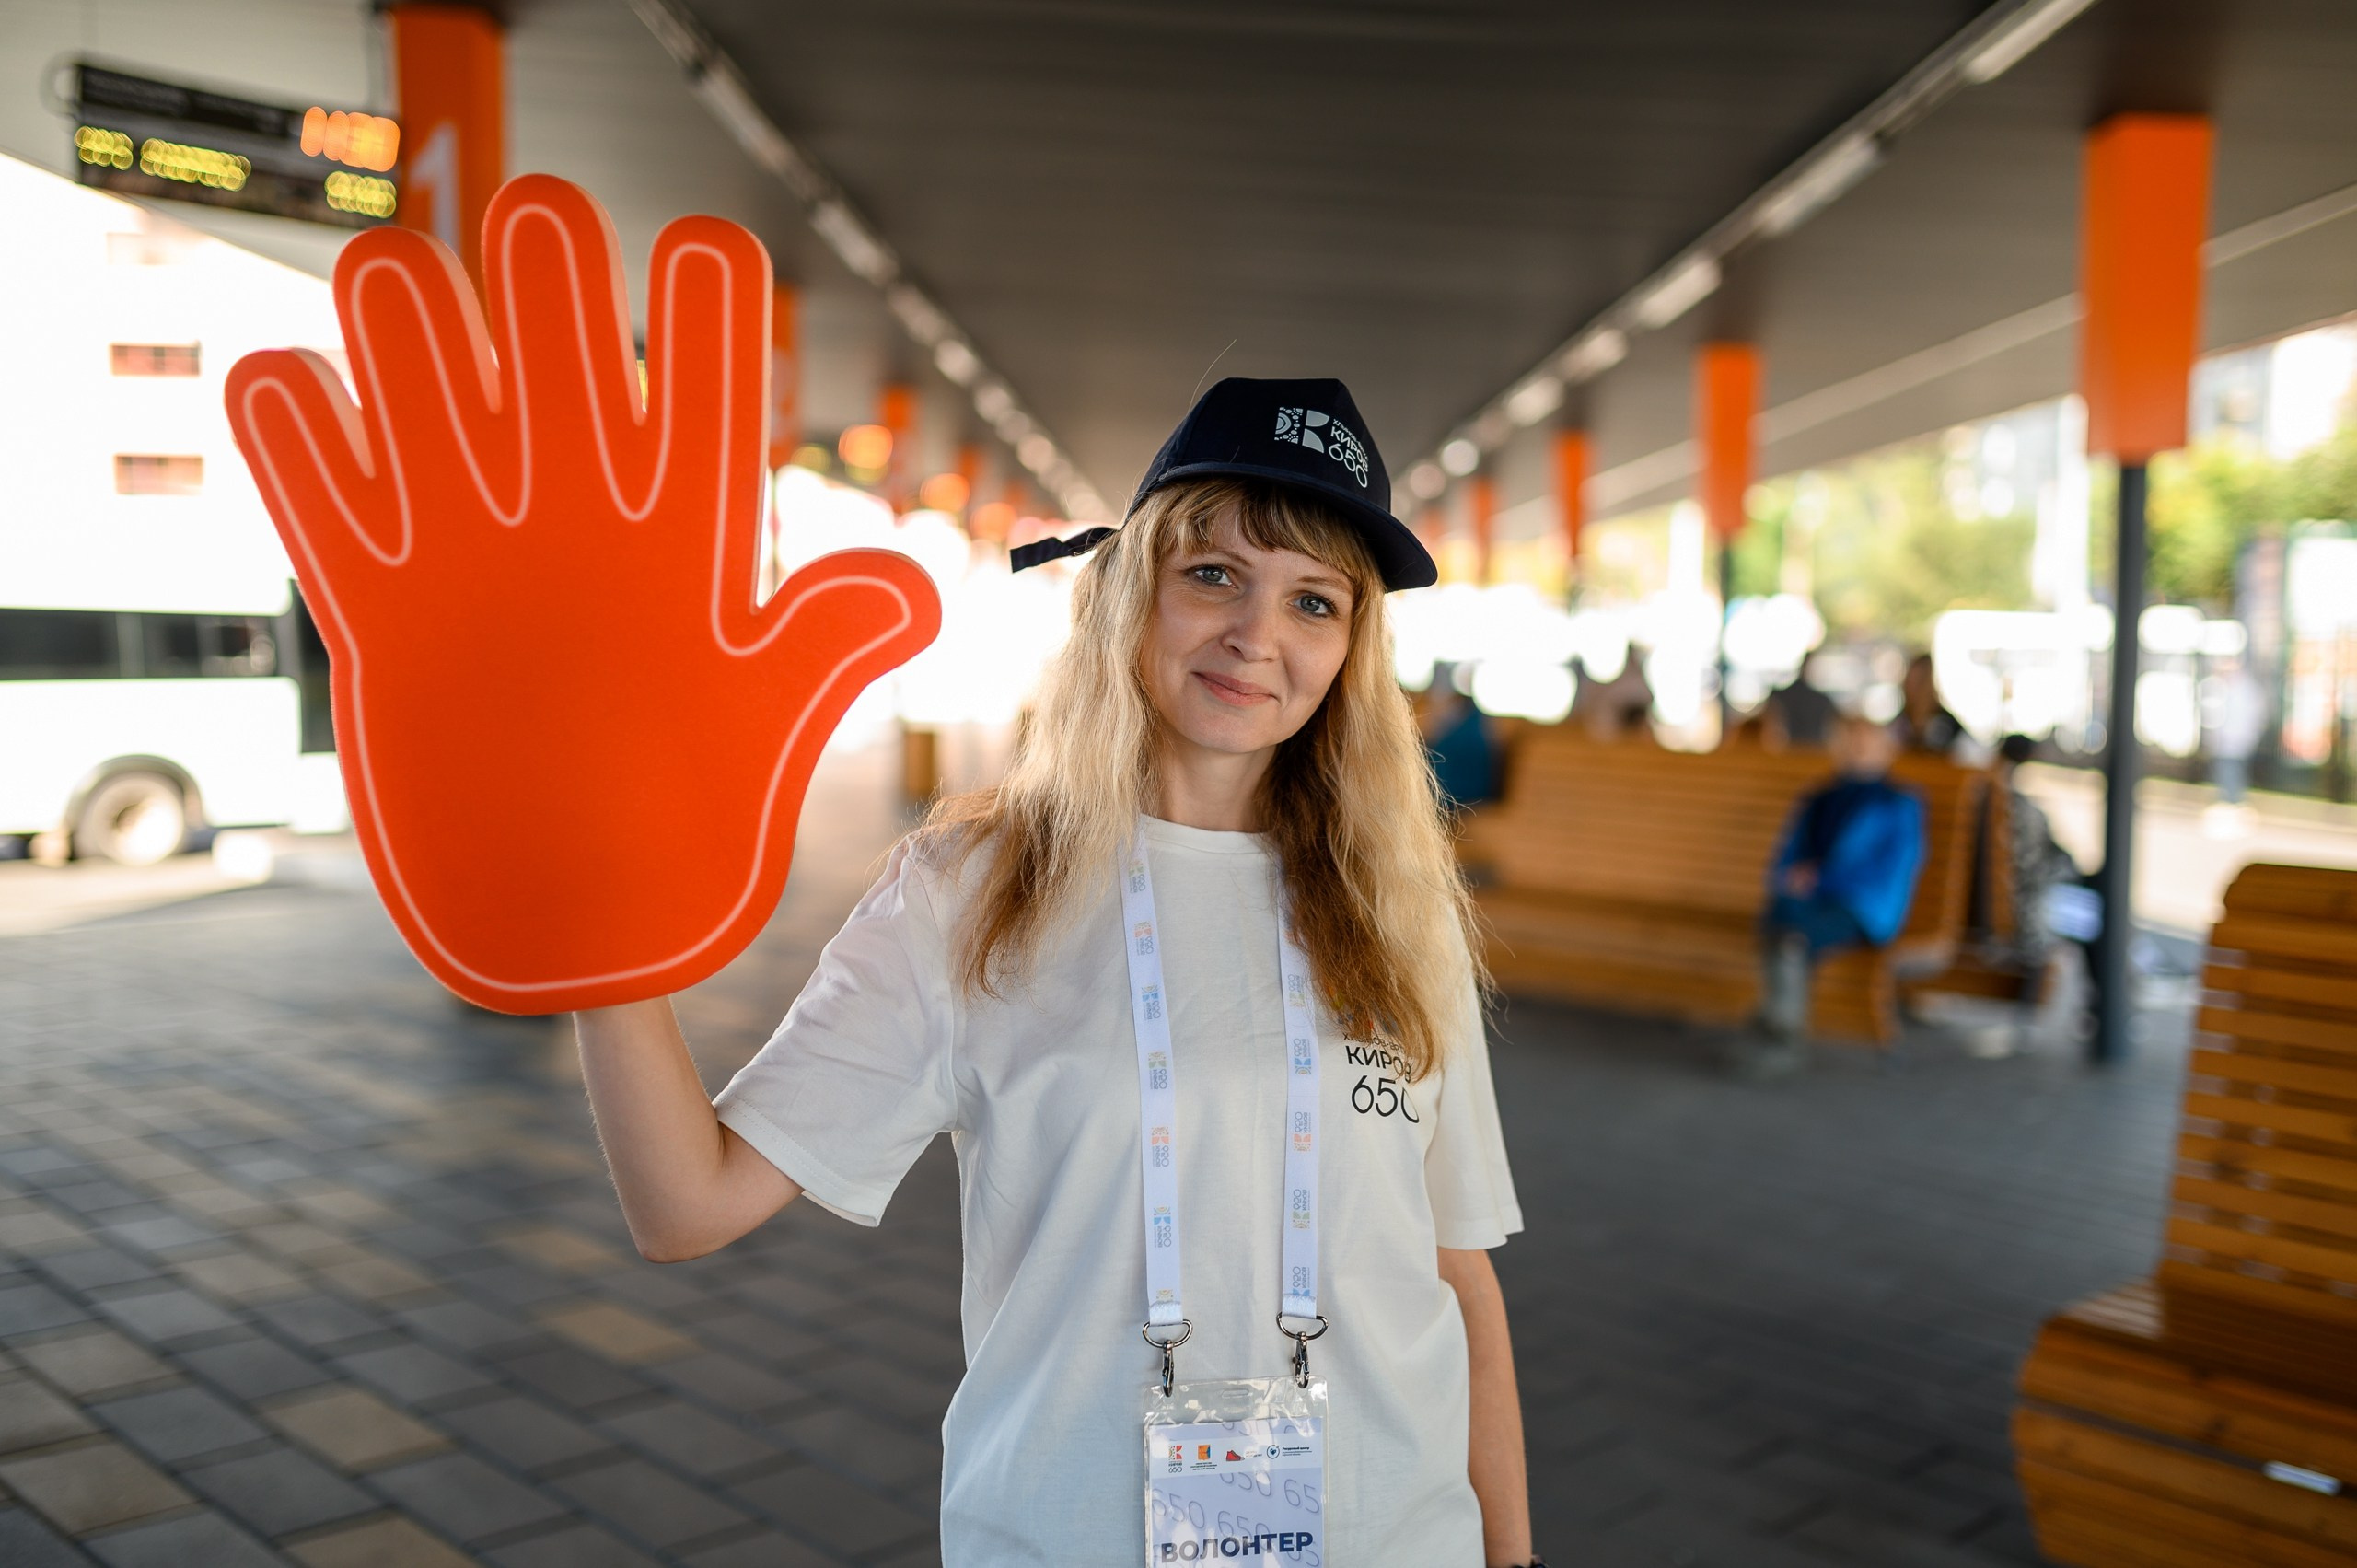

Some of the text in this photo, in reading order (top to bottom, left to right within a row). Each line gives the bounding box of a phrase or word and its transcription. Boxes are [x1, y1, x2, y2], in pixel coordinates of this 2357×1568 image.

[1329, 443, 1368, 488] 650
[1330, 426, 1369, 472] КИРОВ
[1345, 1045, 1411, 1084] КИРОВ
[1161, 1531, 1314, 1563] ВОЛОНТЕР
